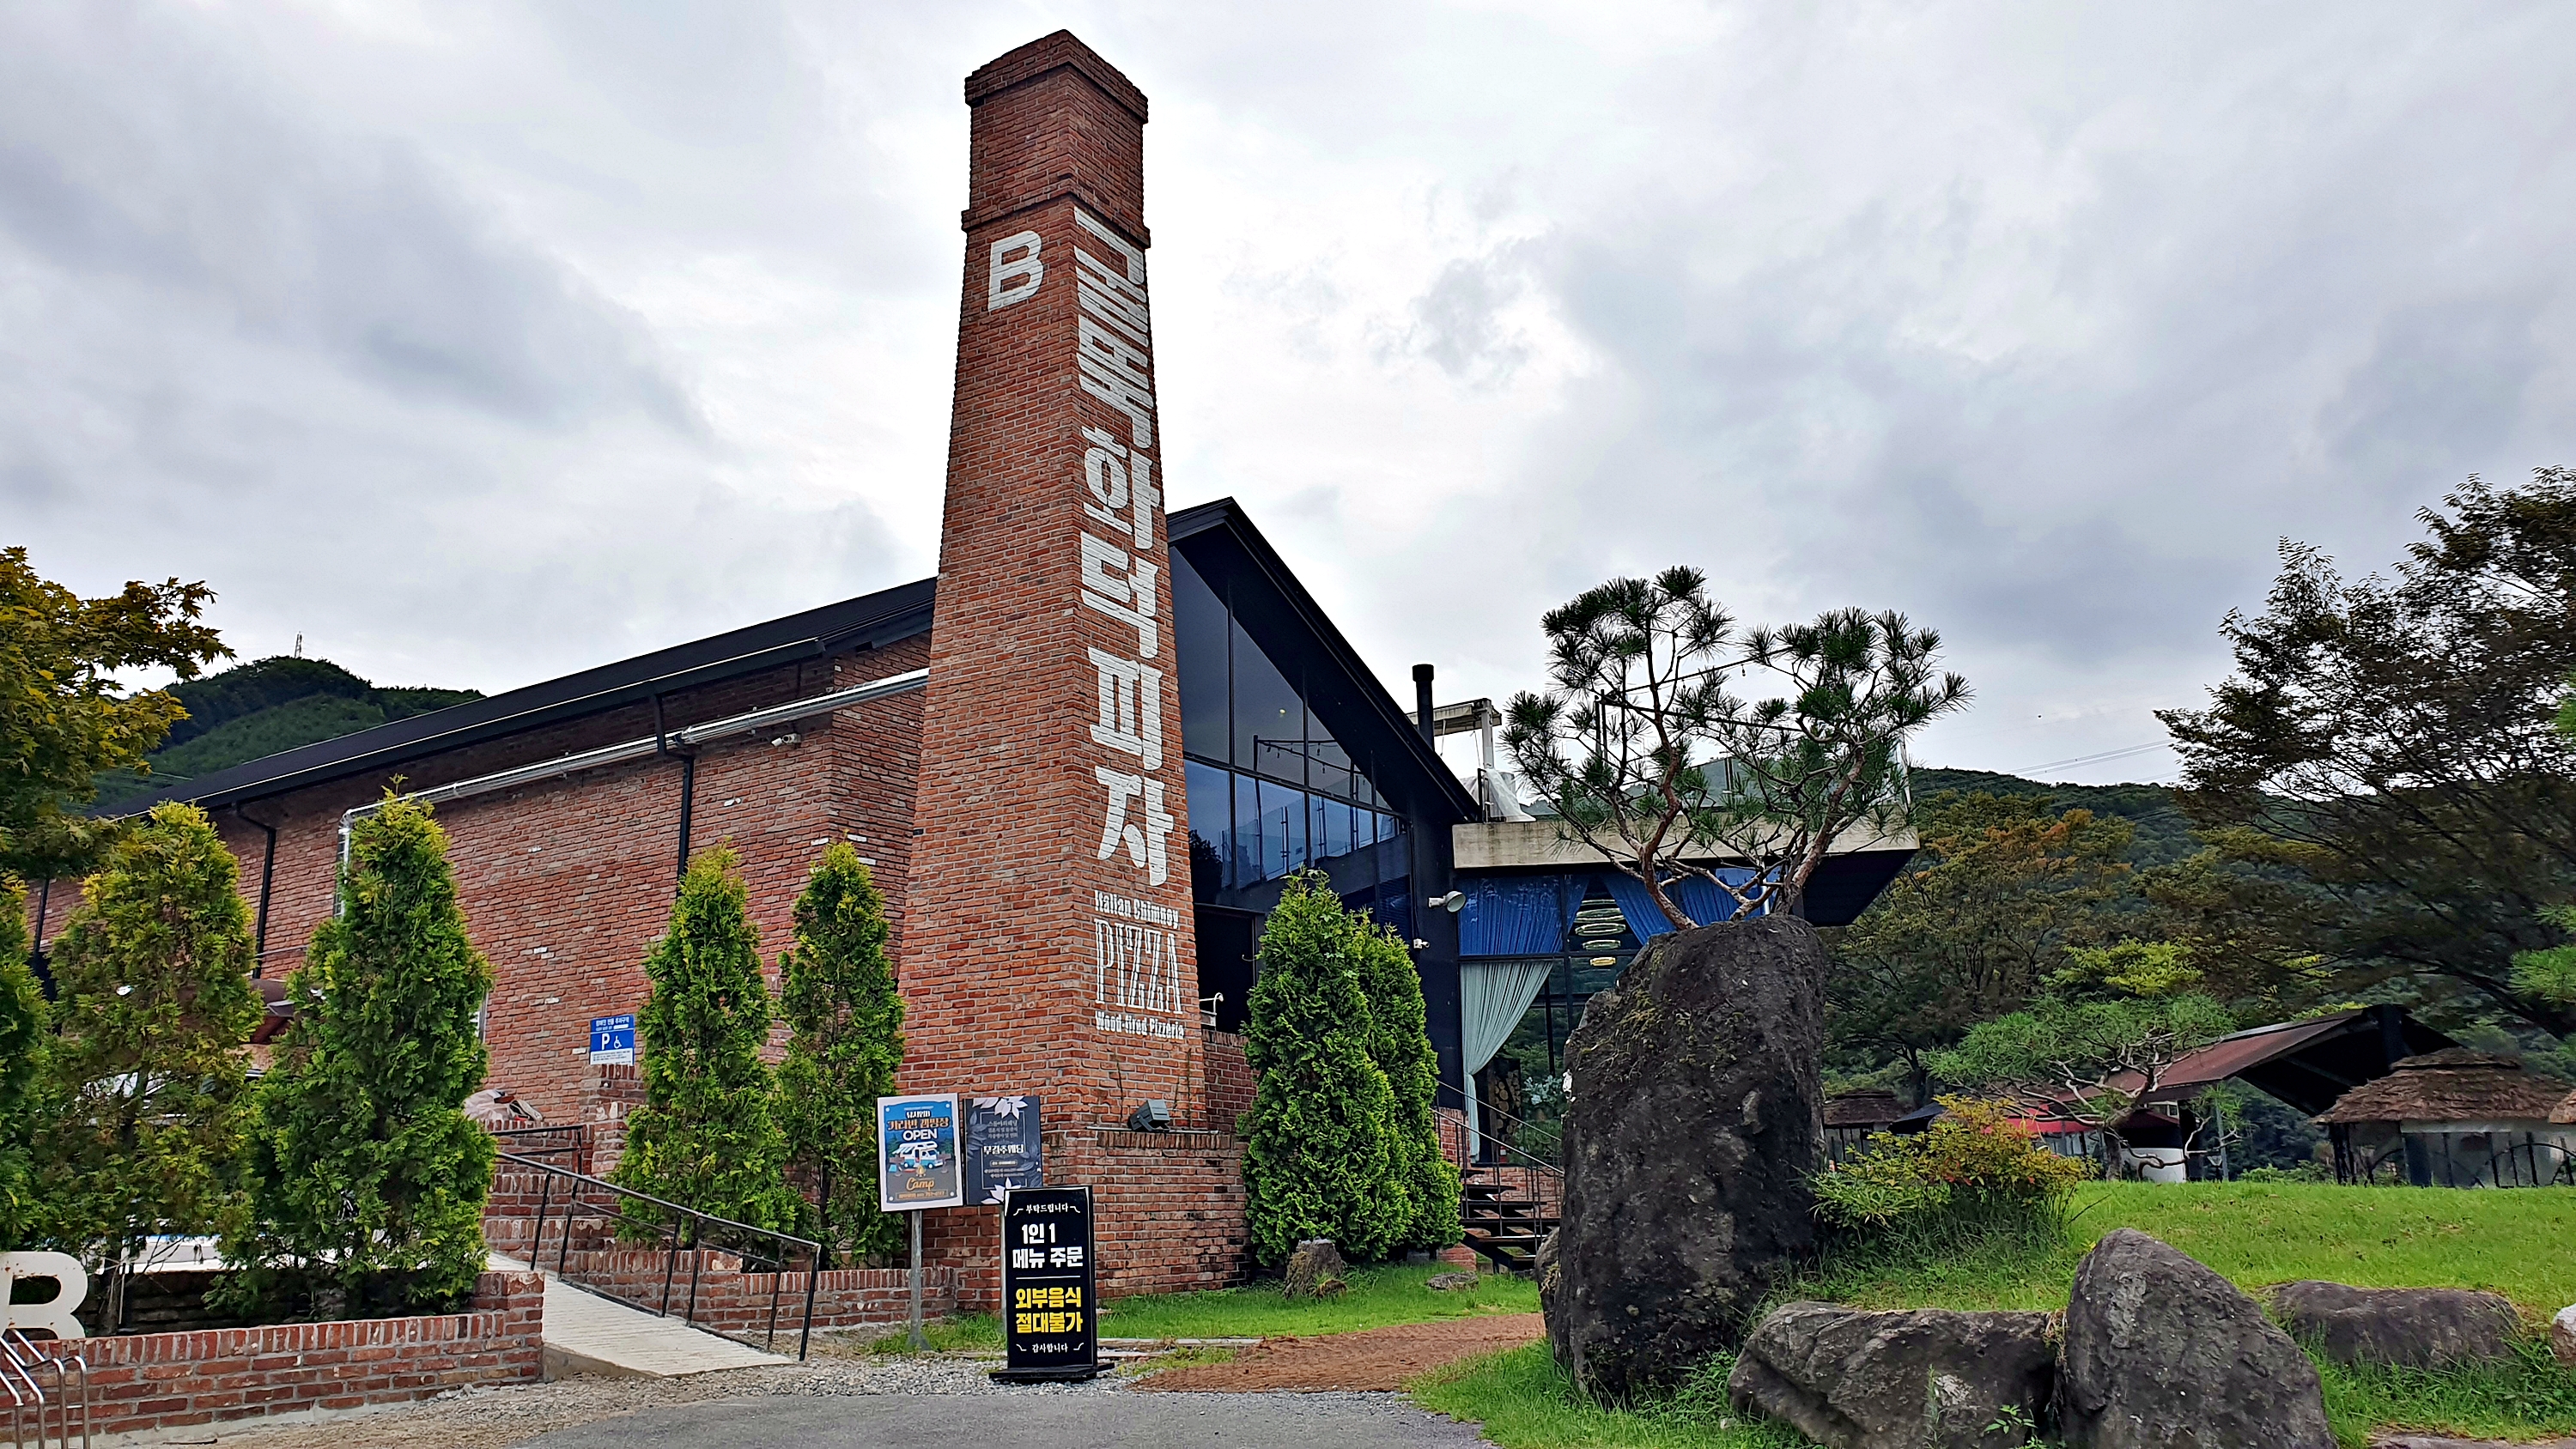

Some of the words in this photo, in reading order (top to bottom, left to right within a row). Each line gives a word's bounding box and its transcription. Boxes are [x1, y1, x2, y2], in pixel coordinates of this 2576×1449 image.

[988, 230, 1045, 312] B
[1095, 890, 1132, 918] Italian
[1133, 898, 1179, 929] Chimney
[1094, 918, 1183, 1015] PIZZA
[1150, 1016, 1185, 1040] Pizzeria
[602, 1033, 611, 1051] P
[888, 1119, 918, 1130] 카라반
[920, 1118, 950, 1129] 캠핑장
[902, 1128, 938, 1141] OPEN
[907, 1177, 935, 1191] Camp
[1025, 1203, 1068, 1214] 부탁드립니다
[1022, 1223, 1045, 1244] 1인
[1048, 1223, 1056, 1243] 1
[1012, 1248, 1045, 1270] 메뉴
[1050, 1246, 1084, 1268] 주문
[1015, 1287, 1082, 1309] 외부음식
[1016, 1312, 1084, 1334] 절대불가
[1031, 1343, 1069, 1354] 감사합니다
